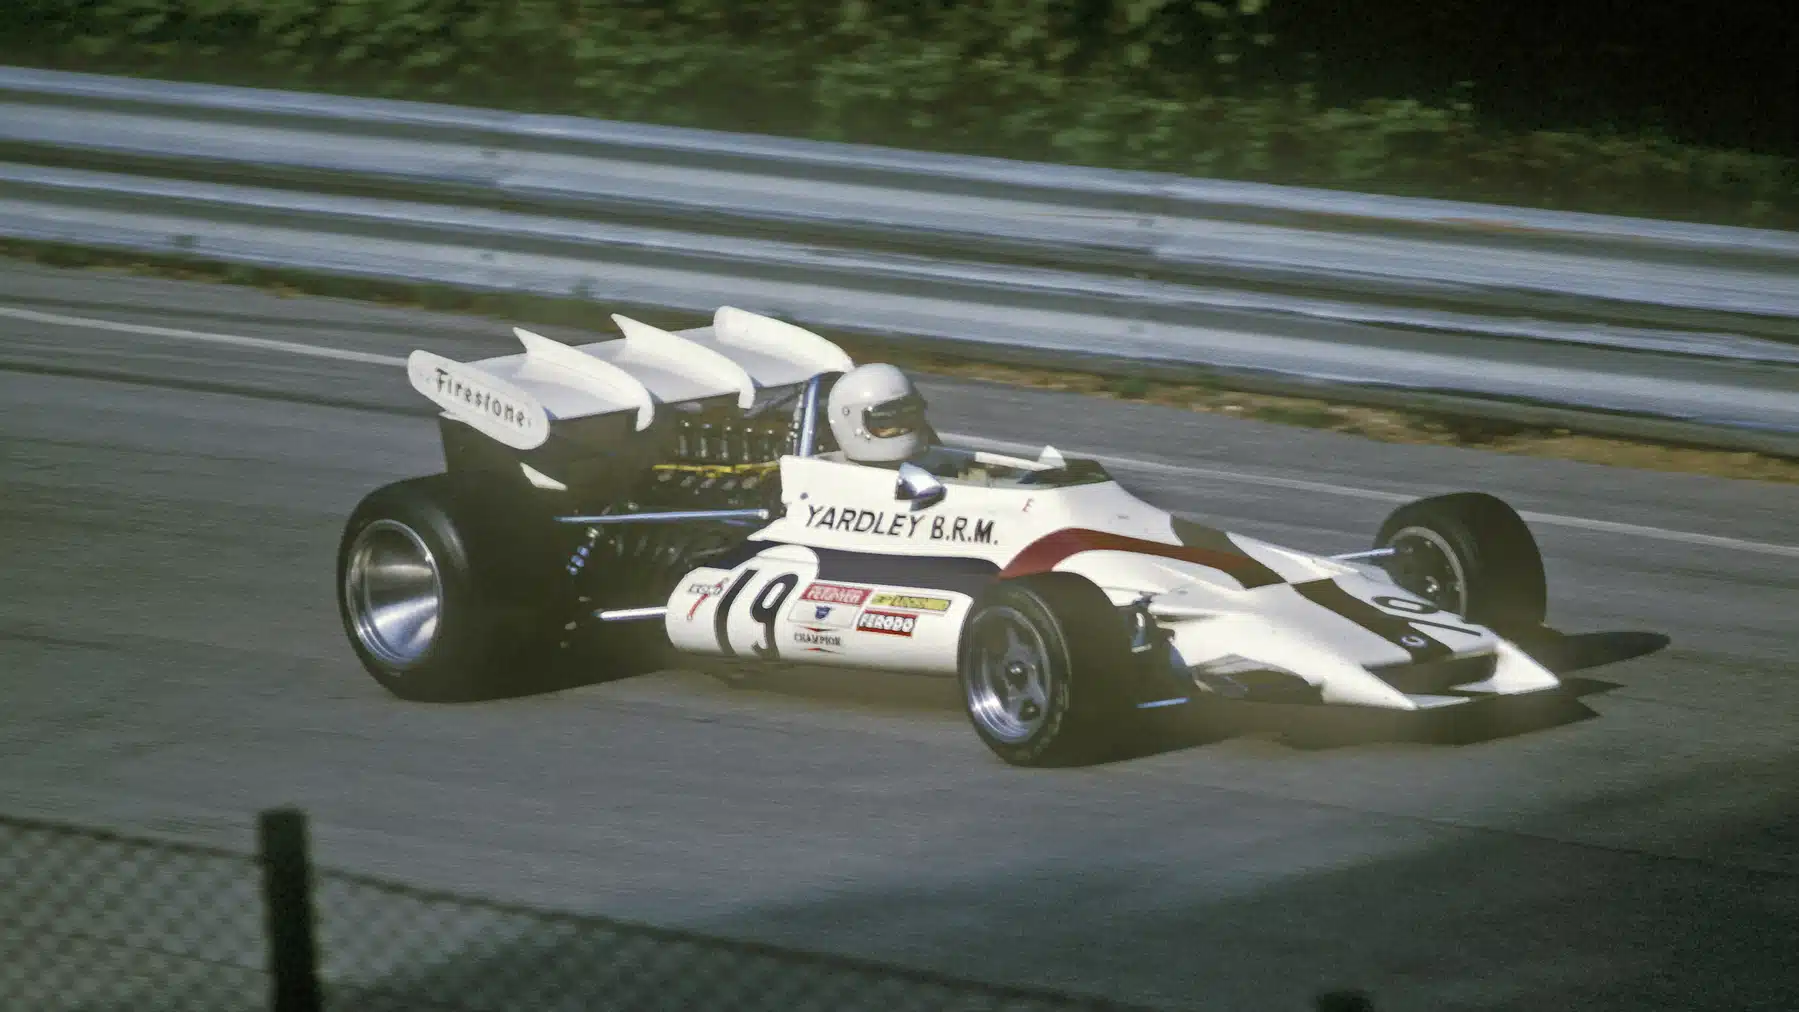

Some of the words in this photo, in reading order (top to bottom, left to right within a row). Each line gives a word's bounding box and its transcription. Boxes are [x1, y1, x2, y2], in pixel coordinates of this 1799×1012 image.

[435, 367, 525, 428] Firestone
[805, 504, 925, 538] YARDLEY
[930, 515, 999, 545] B.R.M.
[714, 568, 799, 658] 19
[858, 613, 914, 632] FERODO
[794, 632, 842, 646] CHAMPION
